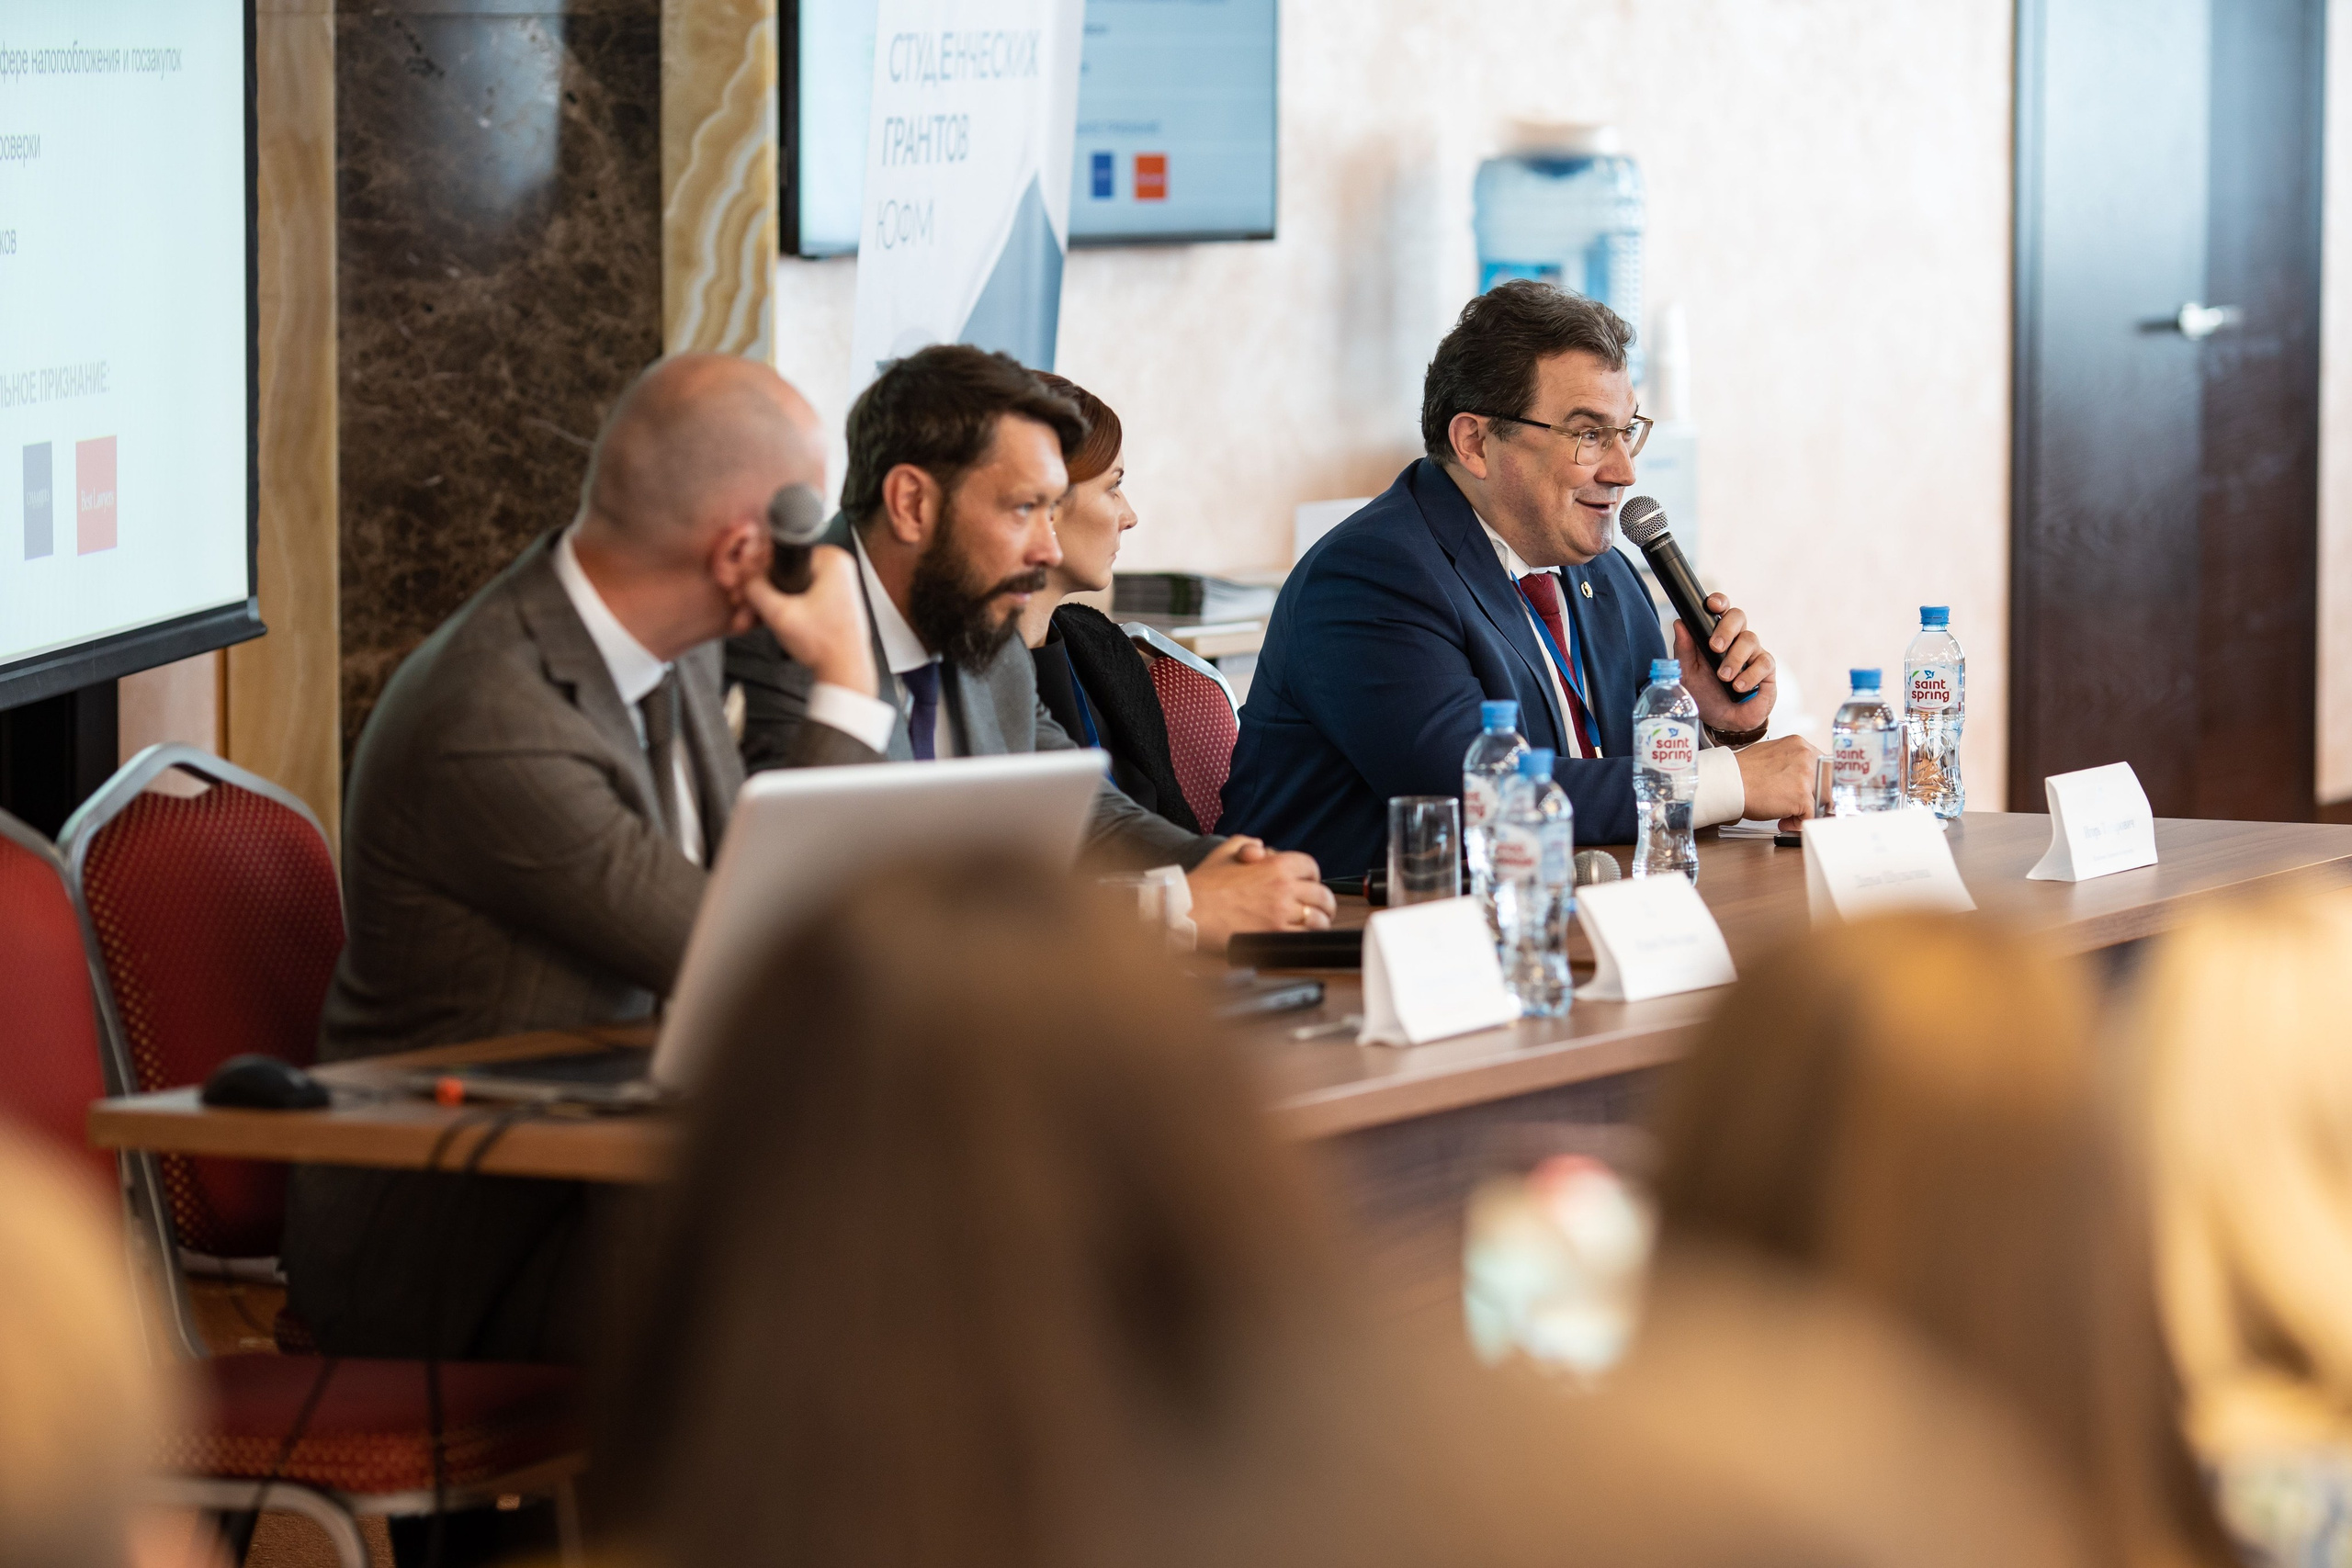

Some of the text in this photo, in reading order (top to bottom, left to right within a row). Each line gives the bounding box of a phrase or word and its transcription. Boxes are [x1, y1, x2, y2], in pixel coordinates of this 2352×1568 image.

[31, 39, 120, 74] налогообложения
[123, 48, 129, 73] и
[131, 48, 182, 81] госзакупок
[888, 30, 1040, 89] СТУДЕНЧЕСКИХ
[882, 113, 970, 167] ГРАНТОВ
[875, 198, 934, 251] ЮФМ
[40, 360, 110, 402] ПРИЗНАНИЕ:
[1911, 691, 1950, 703] spring
[1915, 679, 1946, 690] saint
[1652, 750, 1692, 763] spring
[1657, 738, 1690, 749] saint
